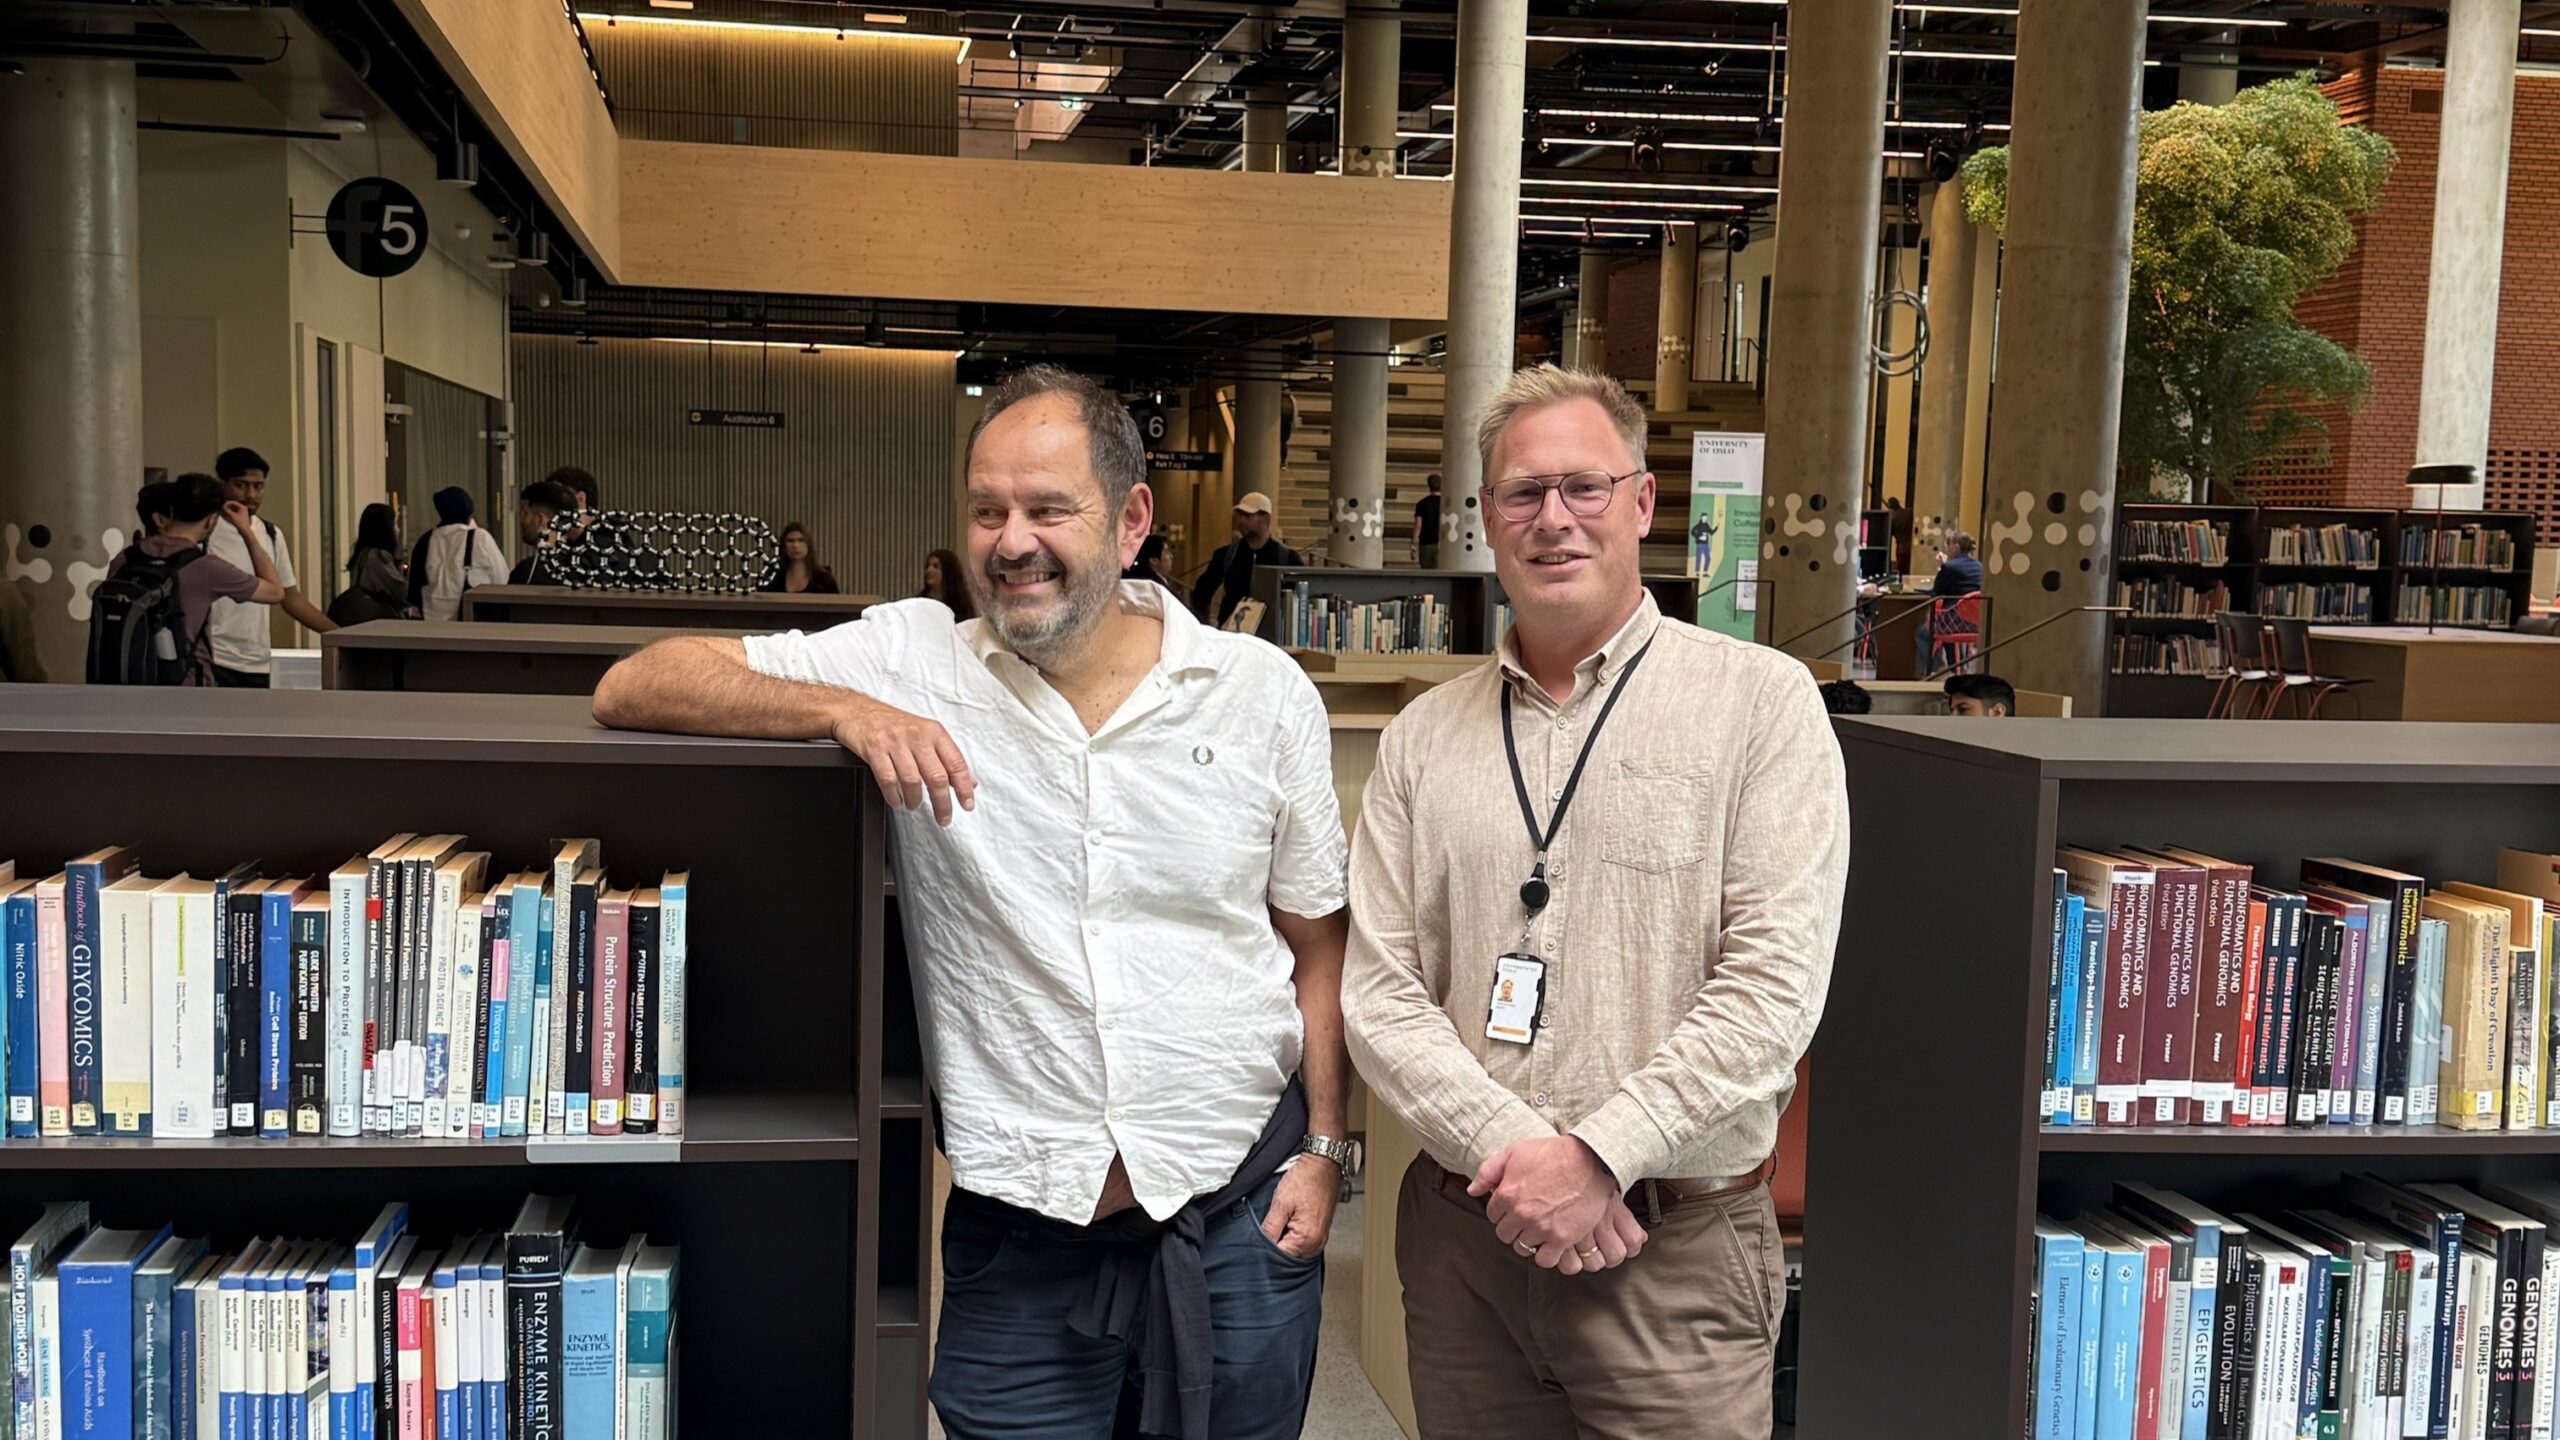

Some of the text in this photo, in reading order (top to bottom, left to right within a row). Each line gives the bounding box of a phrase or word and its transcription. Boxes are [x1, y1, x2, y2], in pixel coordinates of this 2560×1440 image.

[380, 204, 417, 256] 5
[722, 413, 775, 426] Auditorium 6
[1148, 415, 1165, 438] 6
[1699, 440, 1750, 449] UNIVERSITY
[75, 874, 87, 929] Handbook
[369, 864, 380, 892] Protein
[441, 886, 450, 902] Lesk
[2160, 883, 2171, 931] third edition
[2208, 879, 2220, 927] third edition
[74, 931, 88, 942] of
[370, 929, 379, 941] and
[384, 869, 395, 983] Protein Structure and Function
[402, 868, 414, 980] Protein Structure and Function
[418, 868, 432, 980] Protein Structure and Function
[512, 931, 524, 970] Animal
[2110, 903, 2120, 931] edition
[2118, 884, 2137, 1009] FUNCTIONAL GENOMICS
[2132, 884, 2150, 996] BIOINFORMATICS AND
[2166, 883, 2186, 1008] FUNCTIONAL GENOMICS
[2180, 883, 2198, 996] BIOINFORMATICS AND
[2215, 879, 2234, 1007] FUNCTIONAL GENOMICS
[2230, 879, 2249, 994] BIOINFORMATICS AND
[2251, 925, 2262, 958] Practical
[2397, 887, 2412, 966] bioinformatics
[15, 943, 26, 999] Nitric Oxide
[310, 972, 319, 981] TO
[369, 944, 379, 979] Function
[435, 956, 447, 1027] PROTEIN SCIENCE
[520, 951, 534, 1013] Methods in
[663, 953, 673, 1025] RECOGNITION
[2248, 959, 2259, 992] Systems
[2346, 987, 2353, 996] IN
[2517, 962, 2527, 1007] MADDOX
[72, 944, 93, 1067] GLYCOMICS
[341, 969, 351, 1037] TO PROTEINS
[479, 958, 490, 1037] INTRODUCTION TO
[492, 1005, 503, 1053] Proteomics
[508, 974, 521, 1034] Proteomics
[576, 991, 585, 1012] Protein
[602, 936, 618, 1086] Protein Structure Prediction
[634, 949, 647, 1074] PROTEIN STABILITY AND FOLDING
[672, 1000, 681, 1042] SURFACE
[2082, 941, 2098, 1070] Knowledge-Based Bioinformatics
[2244, 993, 2256, 1022] Biology
[2258, 956, 2279, 1074] Genomics and Bioinformatics
[2276, 956, 2298, 1074] Genomics and Bioinformatics
[2309, 964, 2327, 1067] SEQUENCE ALIGNMENT
[2324, 966, 2341, 1066] SEQUENCE ALIGNMENT
[2486, 925, 2501, 1072] The Eighth Day of Creation
[271, 1016, 281, 1090] Cell Stress Proteins
[2363, 1006, 2380, 1075] Systems Biology
[2445, 1241, 2457, 1289] Biochemical
[15, 1265, 28, 1373] HOW PROTEINS WORK
[525, 1317, 535, 1365] CATALYSIS
[534, 1291, 548, 1364] ENZYME
[568, 1333, 609, 1343] ENZYME
[2170, 1289, 2187, 1374] EPIGENETICS
[2220, 1304, 2236, 1381] EVOLUTION
[2243, 1273, 2261, 1343] Epigenetics
[2261, 1296, 2274, 1386] MOLECULAR POPULATION
[2277, 1296, 2290, 1386] MOLECULAR POPULATION
[2291, 1293, 2304, 1382] MOLECULAR POPULATION
[2441, 1290, 2454, 1326] Pathways
[2498, 1278, 2517, 1369] GENOMES
[2521, 1277, 2540, 1368] GENOMES
[97, 1351, 106, 1393] Handbook
[566, 1343, 610, 1352] KINETICS
[2051, 1276, 2070, 1437] Elements of Evolutionary Genetics
[2192, 1308, 2211, 1409] EPIGENETICS
[2309, 1319, 2325, 1406] Evolutionary Genetics
[2379, 1310, 2391, 1391] Evolutionary Genetics
[2392, 1310, 2406, 1391] Evolutionary Genetics
[2415, 1325, 2432, 1421] Molecular Evolution
[2477, 1325, 2490, 1375] GENOMES
[84, 1369, 94, 1430] of Amino Acids
[2237, 1377, 2249, 1408] Richard
